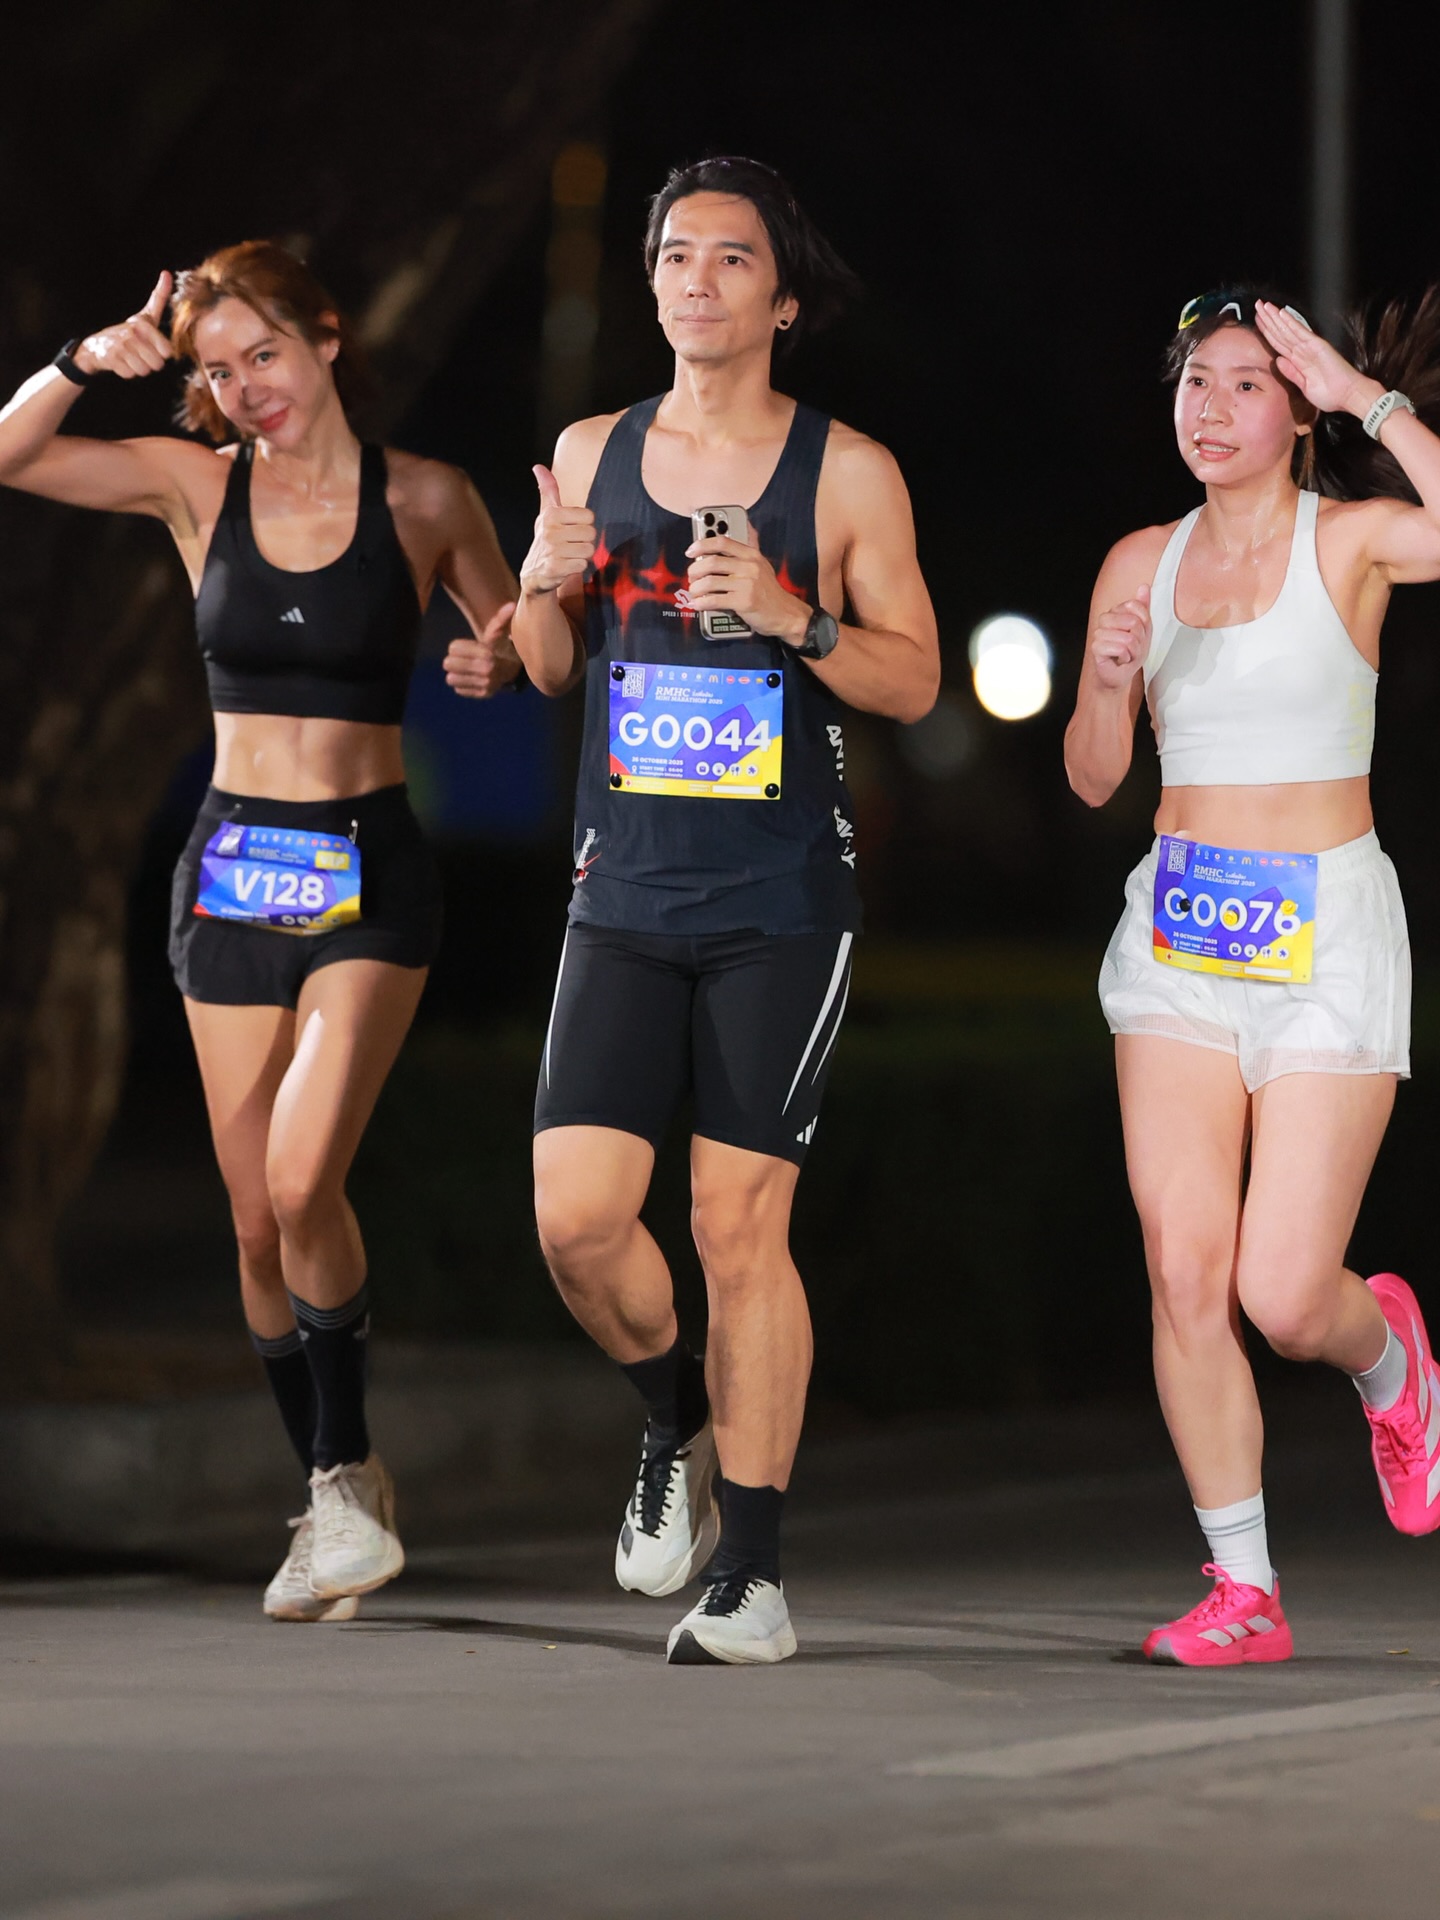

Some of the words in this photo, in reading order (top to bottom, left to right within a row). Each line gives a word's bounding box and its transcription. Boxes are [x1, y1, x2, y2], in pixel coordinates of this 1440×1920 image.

[655, 686, 691, 697] RMHC
[671, 696, 707, 704] MARATHON
[618, 711, 772, 753] G0044
[319, 853, 347, 867] VIP
[1194, 864, 1224, 878] RMHC
[234, 867, 326, 909] V128
[1179, 932, 1204, 942] OCTOBER
